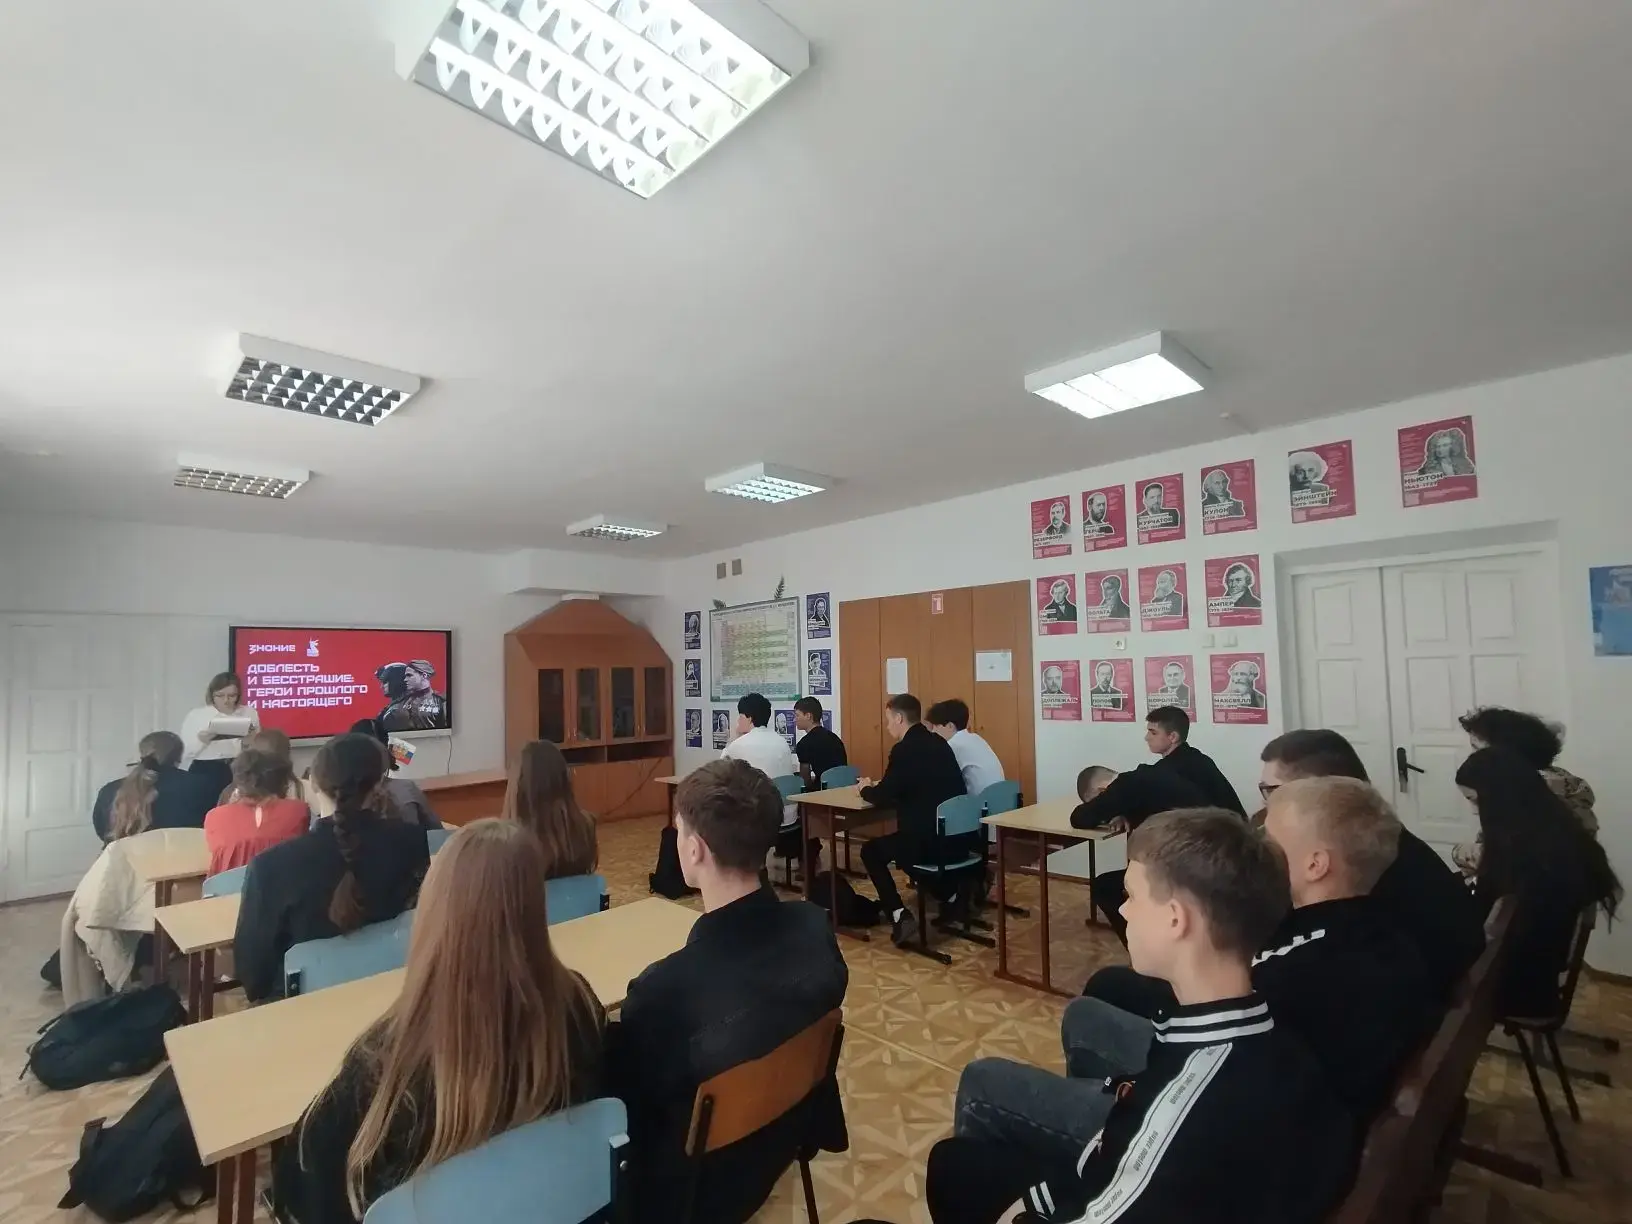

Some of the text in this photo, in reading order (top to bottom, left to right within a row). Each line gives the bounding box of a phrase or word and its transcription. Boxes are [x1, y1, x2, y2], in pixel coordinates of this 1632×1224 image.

[247, 663, 320, 675] ДОБЛЕСТЬ
[247, 676, 258, 685] И
[247, 684, 368, 697] ГЕРОИ ПРОШЛОГО
[247, 696, 353, 709] И НАСТОЯЩЕГО
